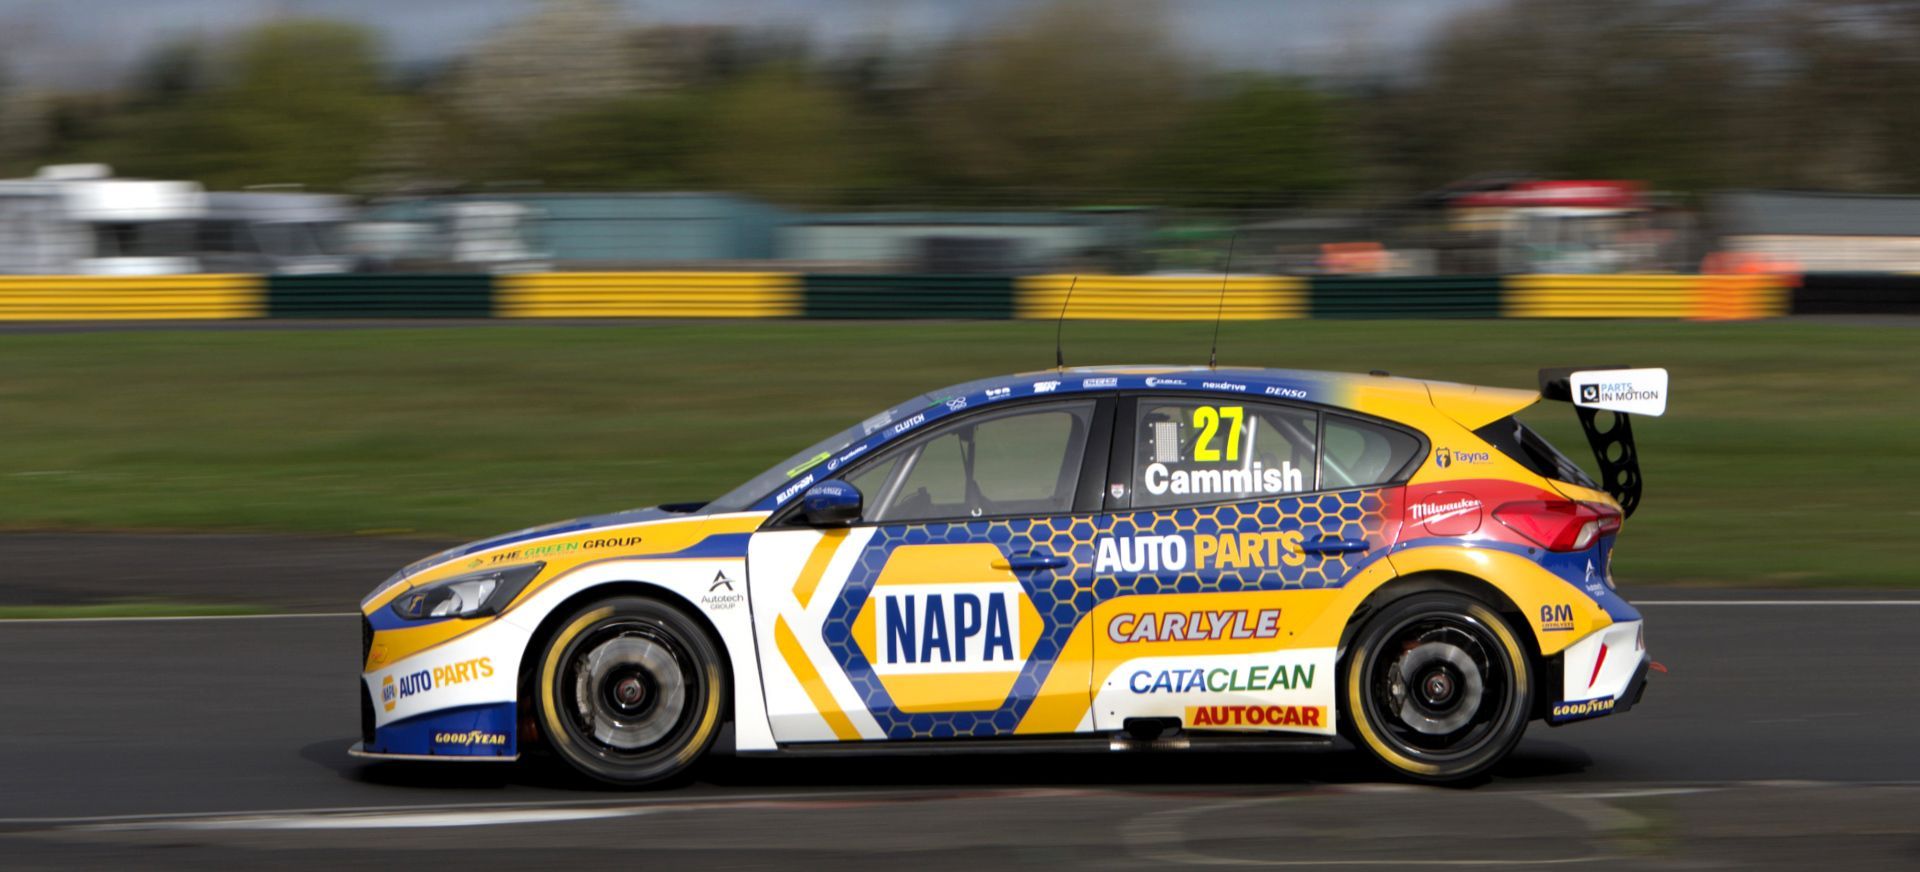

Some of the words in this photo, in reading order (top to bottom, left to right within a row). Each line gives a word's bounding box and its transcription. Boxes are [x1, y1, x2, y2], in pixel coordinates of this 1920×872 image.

[1202, 381, 1247, 391] nexdrive
[1265, 386, 1307, 398] DENSO
[1601, 383, 1633, 392] PARTS
[1601, 392, 1612, 401] IN
[1616, 390, 1659, 401] MOTION
[894, 413, 925, 434] CLUTCH
[1193, 405, 1244, 462] 27
[1453, 451, 1490, 464] Tayna
[1144, 461, 1303, 495] Cammish
[491, 550, 521, 563] THE
[524, 542, 579, 557] GREEN
[583, 537, 642, 549] GROUP
[1095, 535, 1187, 572] AUTO
[1194, 531, 1306, 569] PARTS
[701, 594, 744, 604] Autotech
[1541, 604, 1574, 622] BM
[886, 592, 1014, 664] NAPA
[1107, 608, 1281, 643] CARLYLE
[383, 684, 396, 701] NAPA
[400, 669, 432, 699] AUTO
[433, 656, 495, 688] PARTS
[1129, 664, 1315, 694] CATACLEAN
[1193, 706, 1320, 727] AUTOCAR
[1553, 698, 1615, 715] GOODYEAR
[435, 730, 506, 745] GOODYEAR
